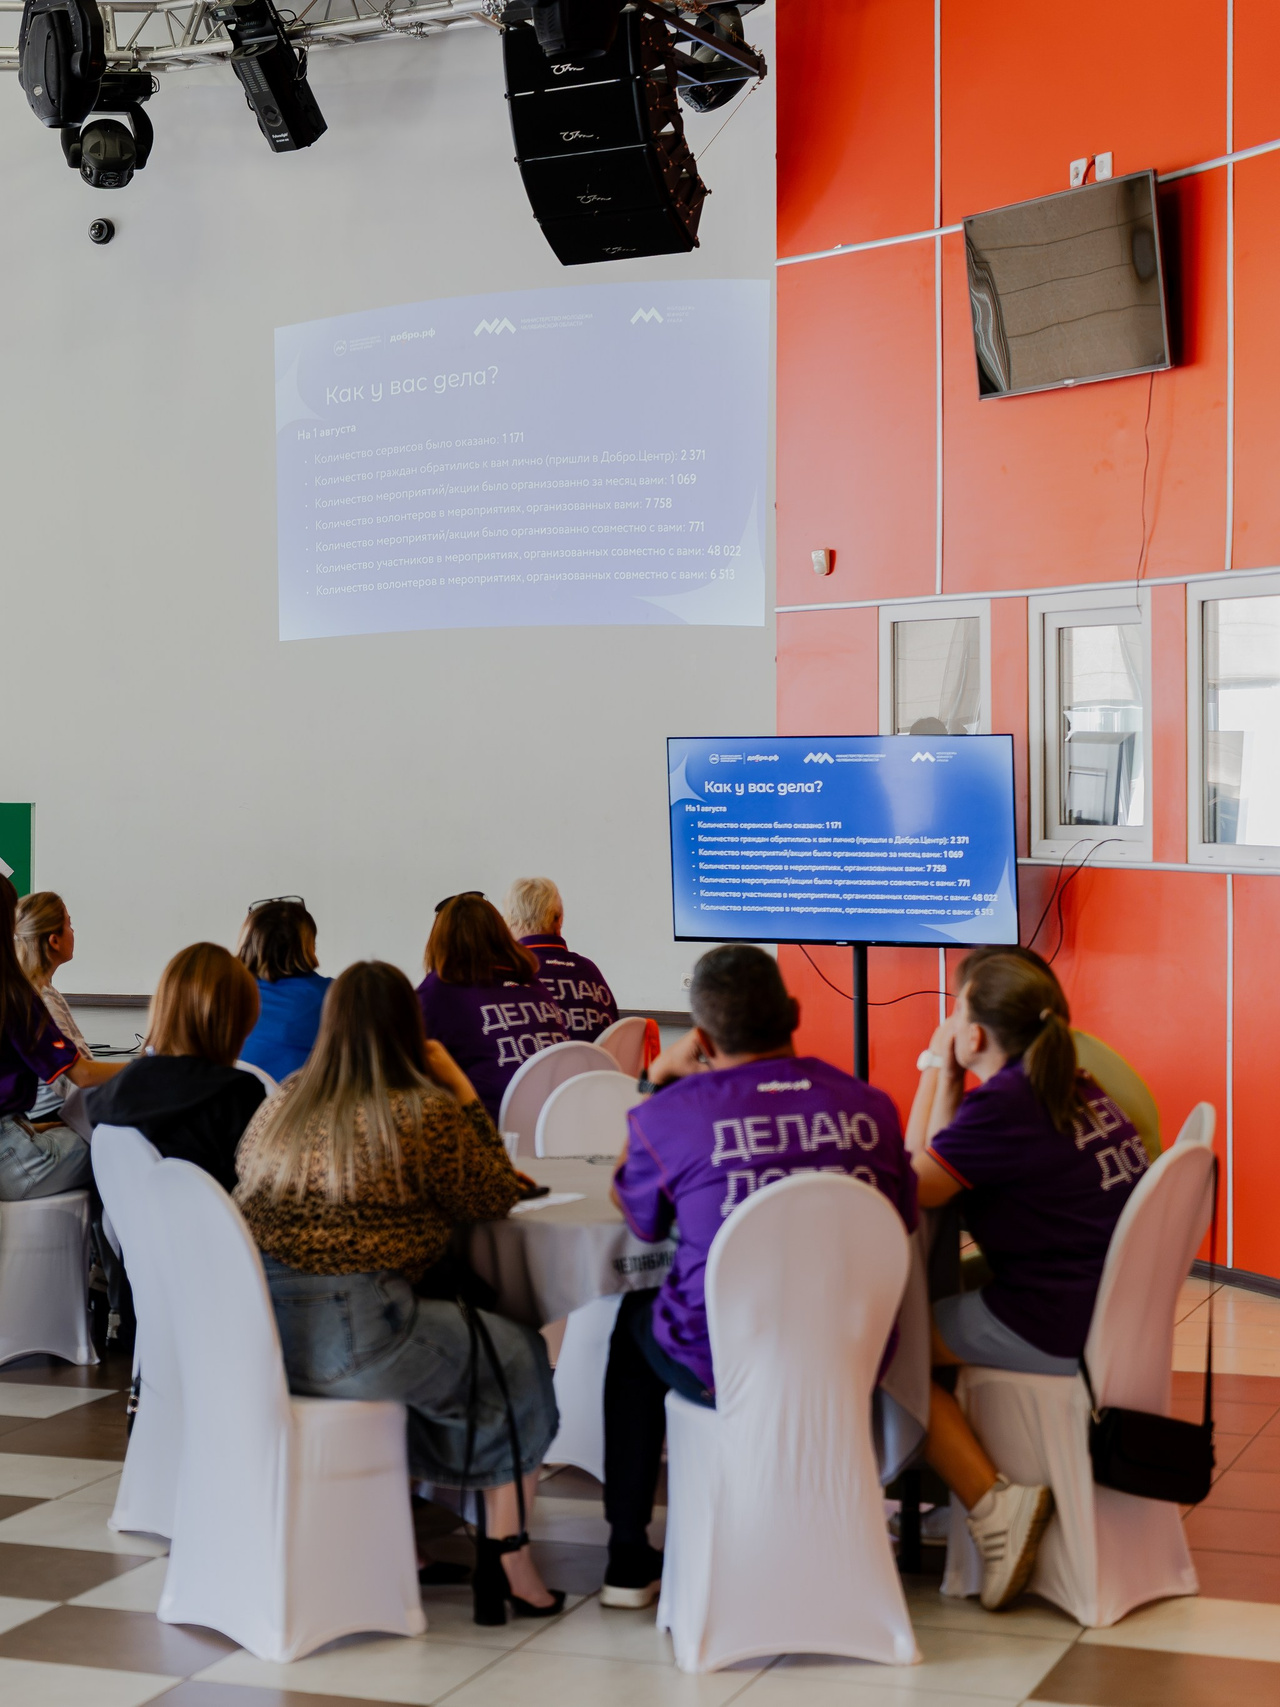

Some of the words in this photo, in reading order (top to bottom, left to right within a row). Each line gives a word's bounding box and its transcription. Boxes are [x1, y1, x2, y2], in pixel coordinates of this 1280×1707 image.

[390, 328, 436, 343] добро.рф
[326, 385, 364, 405] Как
[372, 382, 383, 402] у
[390, 377, 427, 395] вас
[434, 366, 498, 394] дела?
[298, 431, 310, 440] На
[313, 428, 317, 438] 1
[320, 425, 356, 437] августа
[314, 449, 373, 464] Количество
[376, 443, 422, 458] сервисов
[426, 439, 452, 450] было
[455, 437, 500, 447] оказано:
[503, 433, 507, 444] 1
[510, 432, 524, 444] 171
[315, 472, 373, 486] Количество
[376, 466, 417, 481] граждан
[420, 461, 480, 476] обратились
[483, 461, 488, 469] к
[491, 460, 509, 468] вам
[512, 457, 543, 467] лично
[546, 454, 590, 468] (пришли
[592, 455, 598, 463] в
[601, 451, 677, 465] Добро.Центр):
[681, 450, 686, 461] 2
[689, 450, 706, 461] 371
[315, 494, 373, 508] Количество
[376, 484, 480, 503] мероприятий/акции
[482, 482, 508, 492] было
[511, 479, 589, 493] организованно
[592, 479, 603, 487] за
[606, 478, 637, 488] месяц
[640, 477, 667, 485] вами:
[670, 474, 674, 485] 1
[677, 474, 697, 485] 069
[315, 517, 373, 531] Количество
[377, 510, 436, 524] волонтеров
[448, 504, 524, 519] мероприятиях,
[526, 501, 611, 515] организованных
[614, 501, 642, 509] вами:
[645, 498, 651, 509] 7
[654, 498, 672, 508] 758
[315, 539, 374, 552] Количество
[377, 529, 480, 547] мероприятий/акции
[482, 527, 508, 537] было
[511, 526, 589, 539] организованно
[592, 525, 646, 533] совместно
[649, 524, 655, 532] с
[658, 524, 685, 532] вами:
[689, 521, 705, 532] 771
[316, 561, 374, 574] Количество
[377, 556, 434, 571] участников
[437, 555, 442, 563] в
[445, 551, 521, 565] мероприятиях,
[524, 549, 608, 562] организованных
[611, 548, 666, 556] совместно
[668, 548, 674, 556] с
[677, 548, 704, 556] вами:
[707, 545, 720, 556] 48
[723, 545, 742, 556] 022
[317, 583, 374, 596] Количество
[377, 578, 437, 590] волонтеров
[448, 574, 524, 587] мероприятиях,
[526, 572, 611, 585] организованных
[614, 571, 668, 579] совместно
[671, 571, 677, 579] с
[679, 571, 707, 580] вами:
[710, 569, 716, 580] 6
[720, 569, 735, 580] 513
[704, 781, 732, 793] Как
[735, 783, 744, 795] у
[748, 783, 774, 793] вас
[777, 780, 823, 795] дела?
[685, 804, 695, 812] На
[696, 804, 700, 812] 1
[539, 978, 612, 1007] ЕЛАЮ
[560, 1008, 613, 1031] ОБРО
[496, 1032, 571, 1067] ДОБР
[710, 1110, 879, 1167] ДЕЛАЮ
